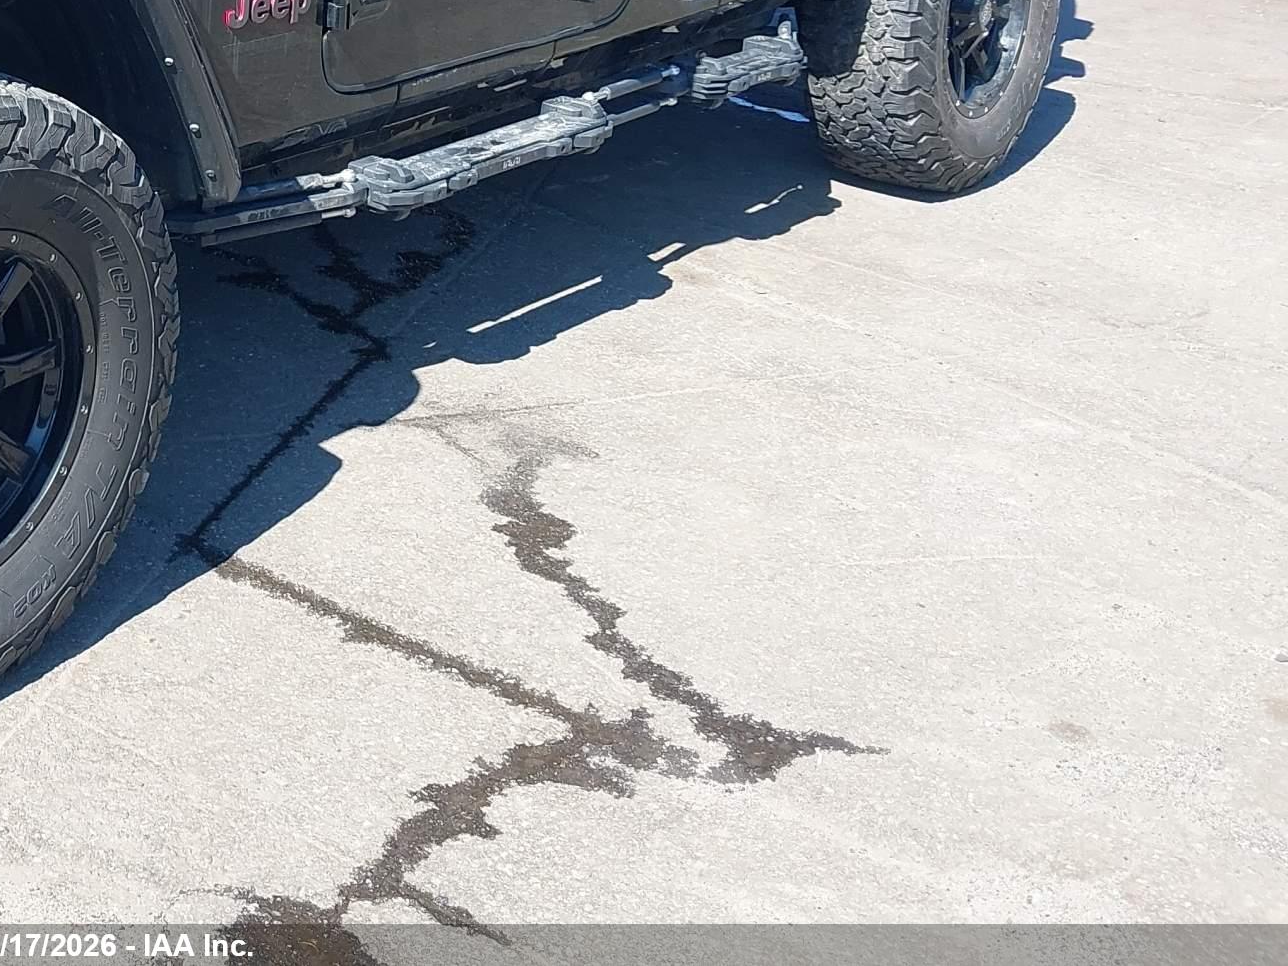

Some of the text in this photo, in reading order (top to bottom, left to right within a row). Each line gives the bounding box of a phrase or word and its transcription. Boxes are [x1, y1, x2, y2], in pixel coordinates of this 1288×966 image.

[11, 191, 139, 620] All-Terrain T/A KO2
